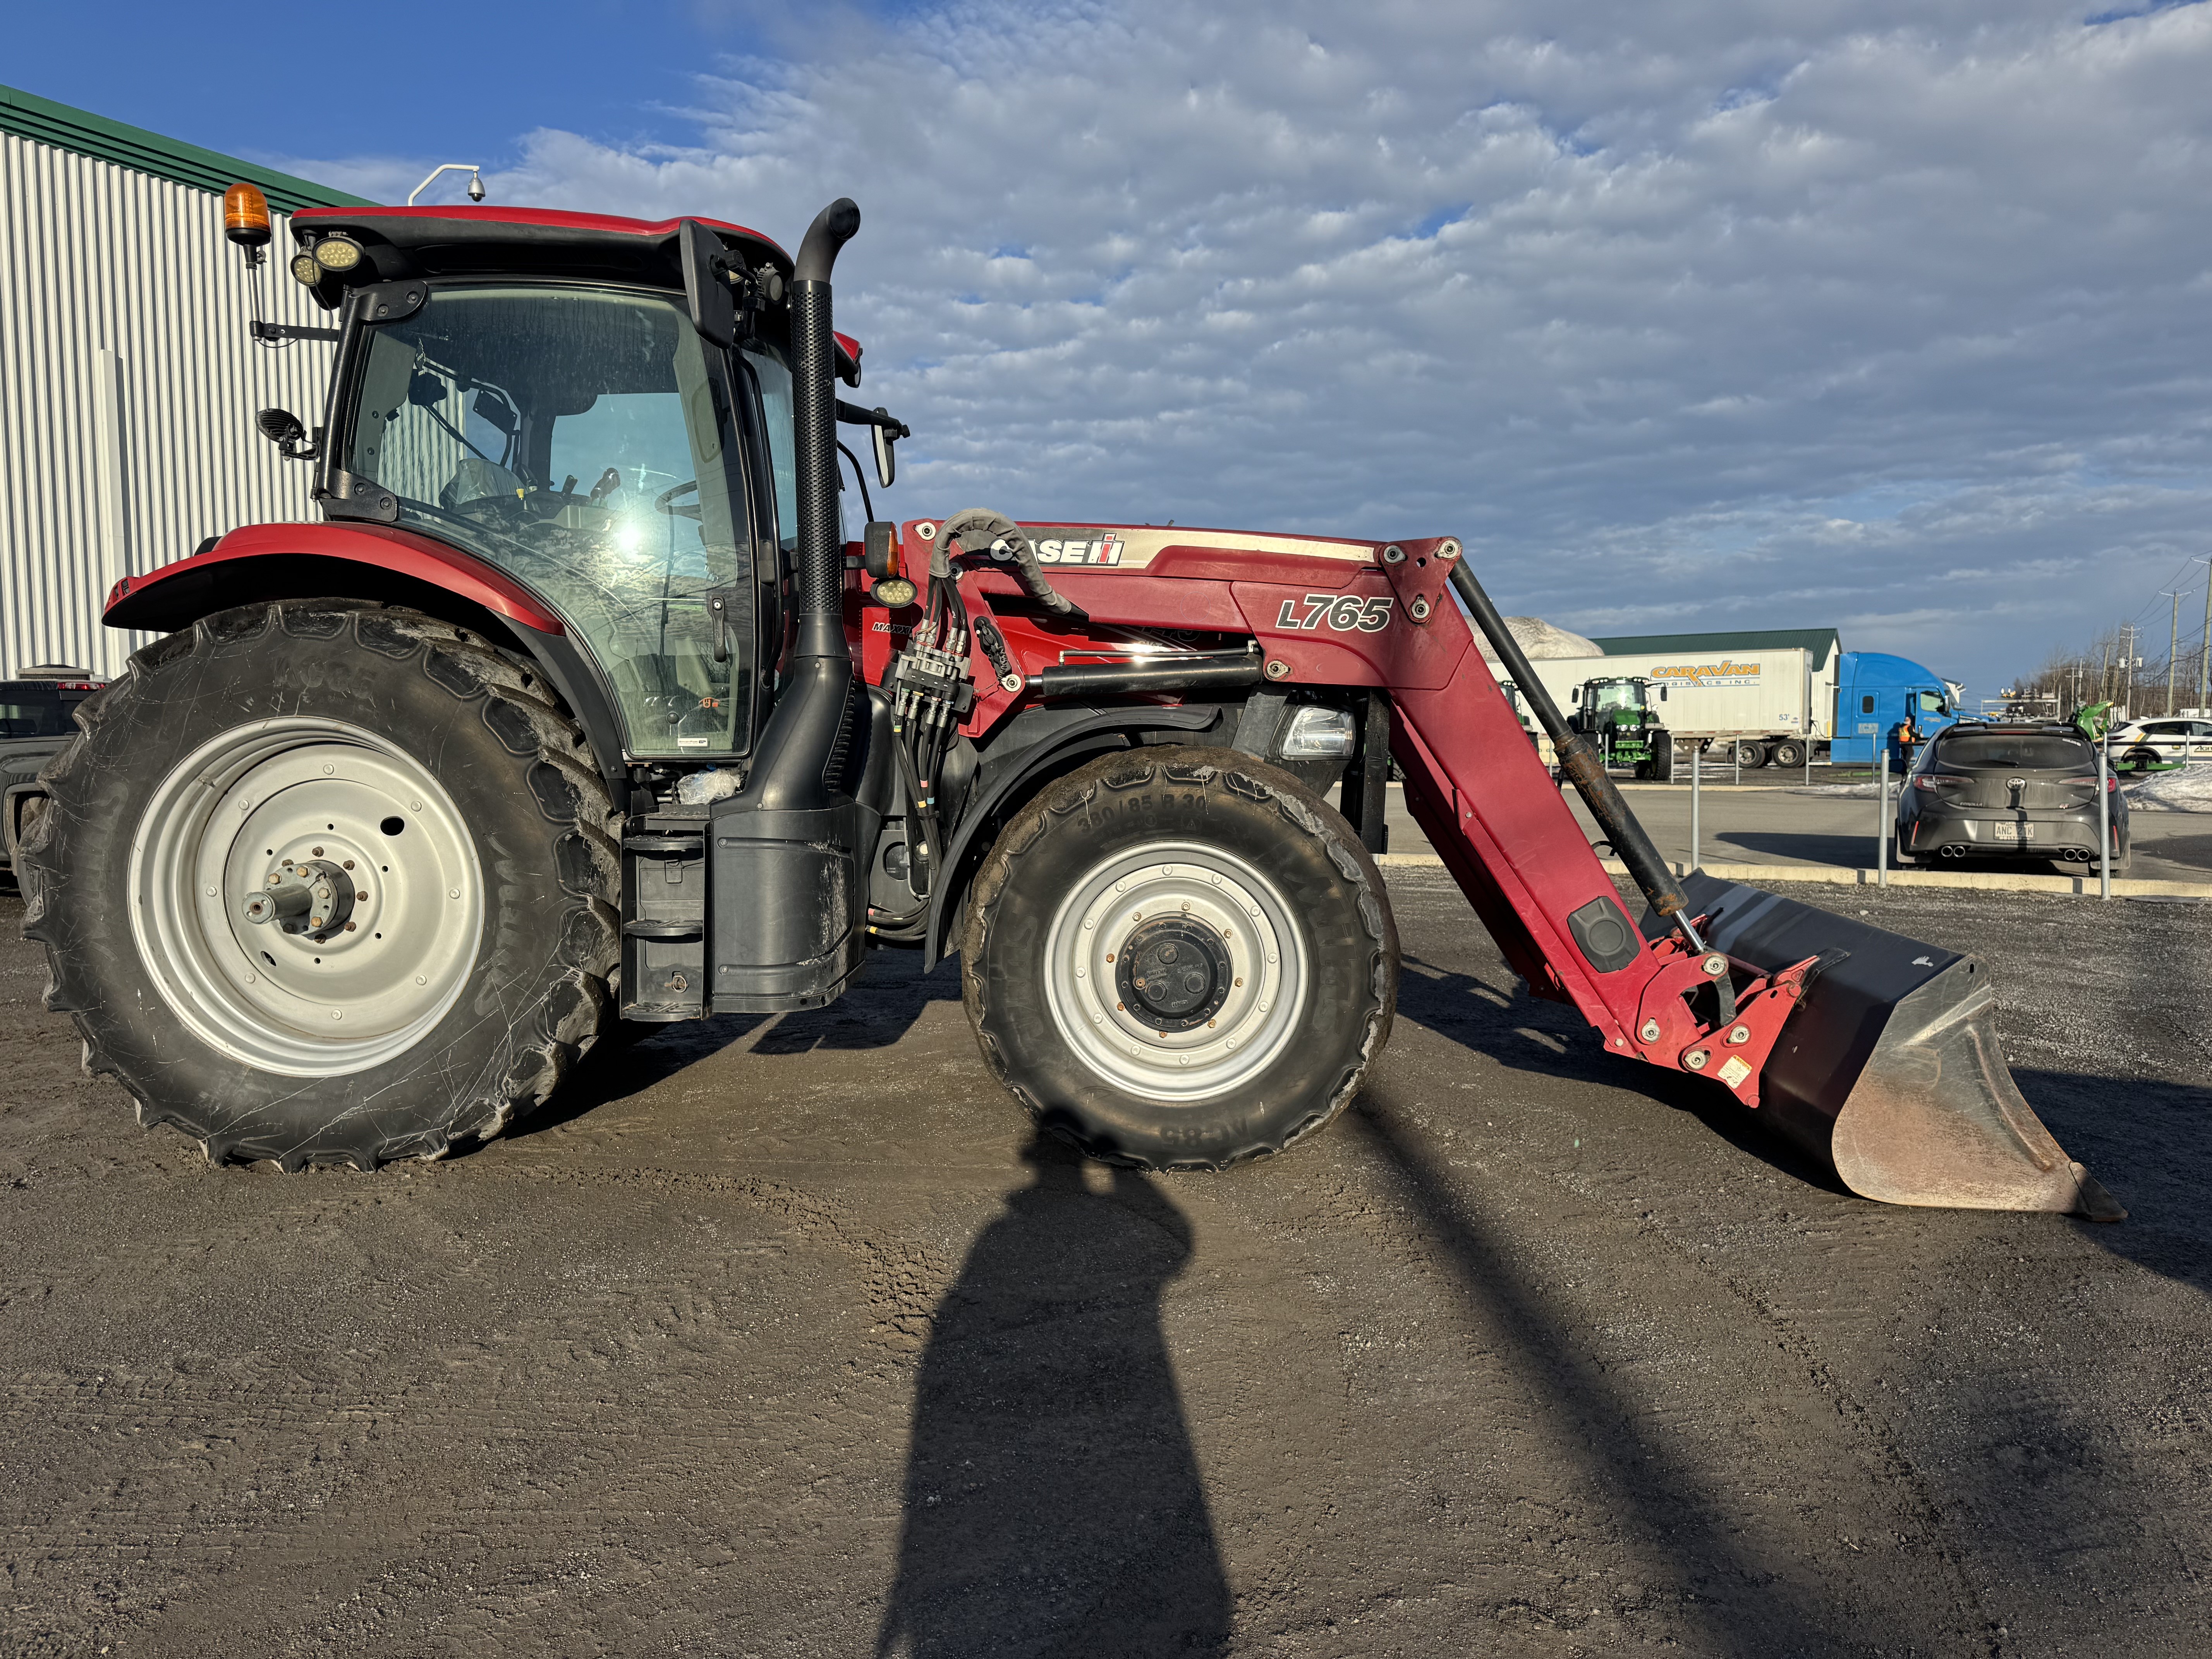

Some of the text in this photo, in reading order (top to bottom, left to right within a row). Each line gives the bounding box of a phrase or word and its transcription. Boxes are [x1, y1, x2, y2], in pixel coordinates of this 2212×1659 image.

[1275, 594, 1394, 633] L765
[1651, 660, 1760, 686] CARAVAN
[1161, 794, 1175, 809] R
[1182, 793, 1207, 811] 30
[1997, 826, 2012, 835] ANC
[1282, 872, 1357, 1035] Mitas
